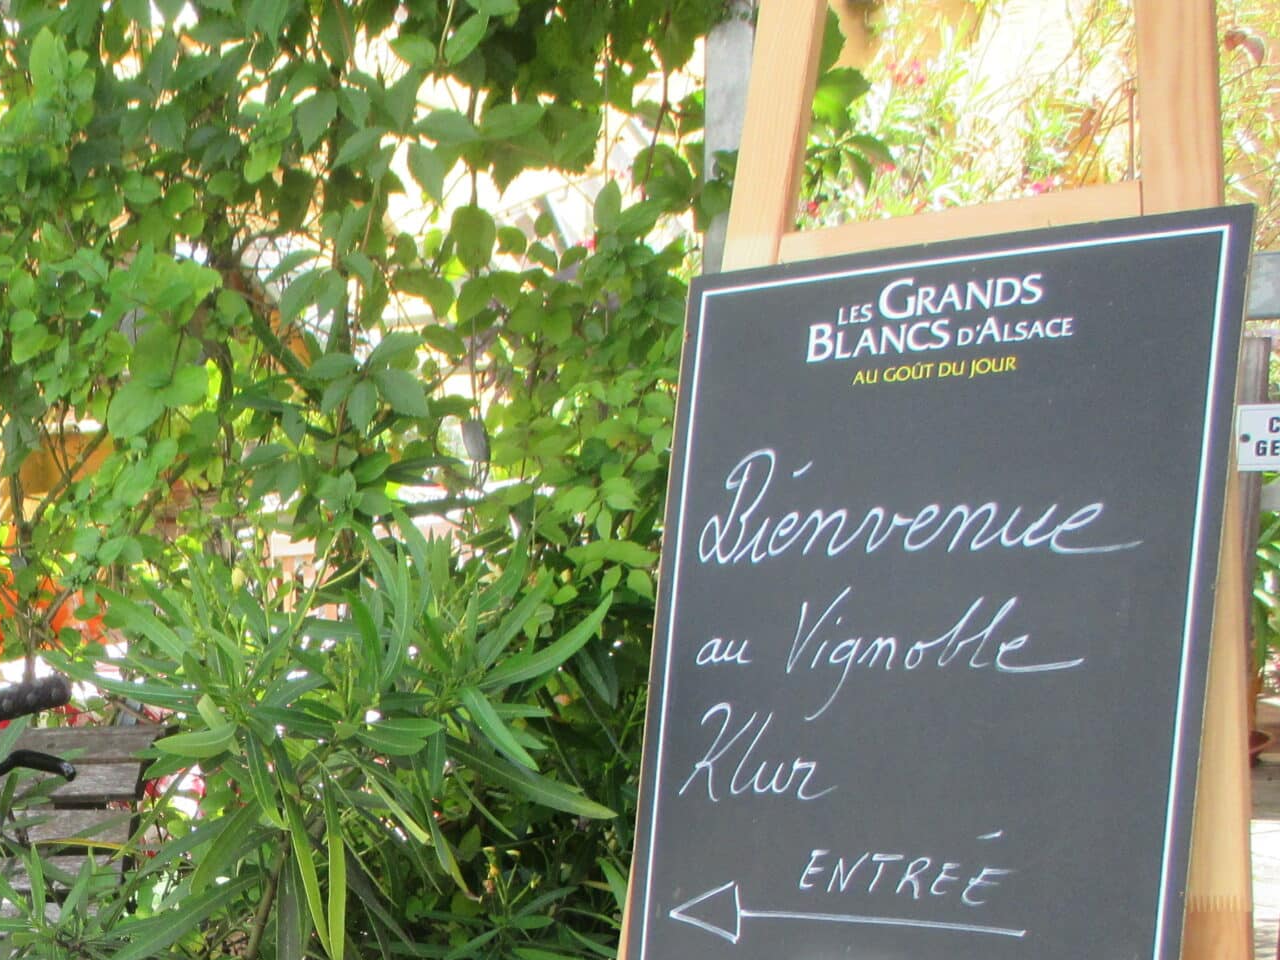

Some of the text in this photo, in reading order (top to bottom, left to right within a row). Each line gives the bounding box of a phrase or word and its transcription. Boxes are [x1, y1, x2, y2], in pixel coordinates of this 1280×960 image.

[838, 273, 1043, 325] LES GRANDS
[806, 319, 951, 363] BLANCS
[852, 368, 878, 386] AU
[937, 360, 965, 377] DU
[968, 356, 1017, 379] JOUR
[698, 448, 1143, 564] Bienvenue
[695, 586, 1085, 721] au Vignoble
